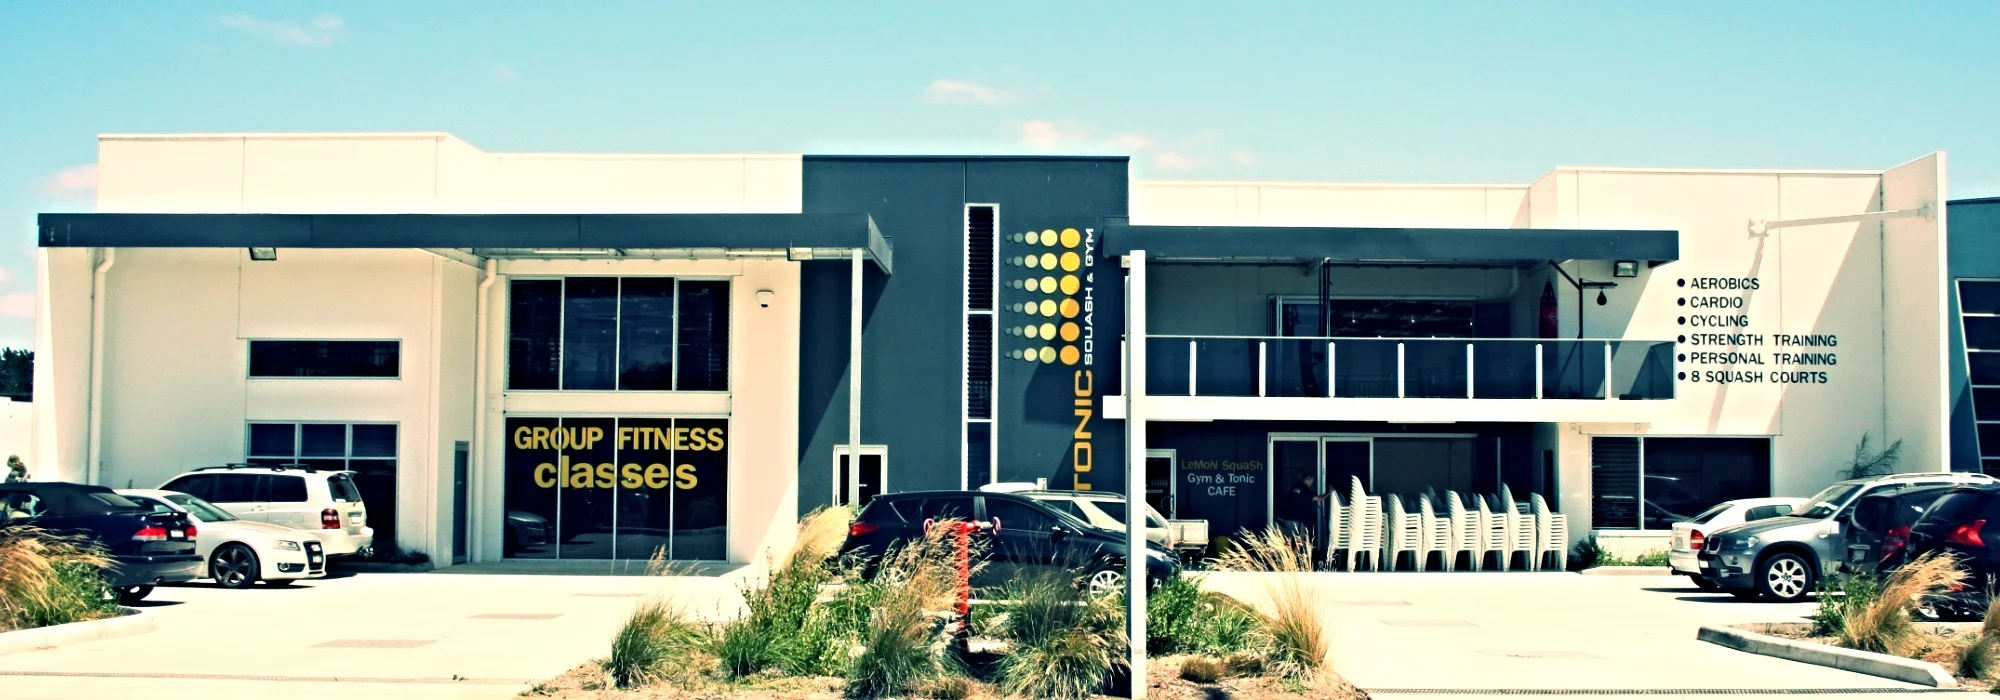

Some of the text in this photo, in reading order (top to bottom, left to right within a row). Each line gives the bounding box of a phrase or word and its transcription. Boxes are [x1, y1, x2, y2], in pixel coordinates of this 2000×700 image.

[1690, 277, 1760, 290] AEROBICS
[1084, 228, 1094, 366] SQUASH & GYM
[1690, 296, 1743, 309] CARDIO
[1690, 315, 1749, 328] CYCLING
[1690, 333, 1838, 347] STRENGTH TRAINING
[1690, 352, 1837, 366] PERSONAL TRAINING
[1691, 371, 1828, 384] 8 SQUASH COURTS
[1074, 370, 1093, 491] TONIC
[514, 426, 725, 451] GROUP FITNESS
[534, 455, 698, 489] classes
[1187, 473, 1255, 485] Gym & Tonic
[1207, 486, 1236, 496] CAFE
